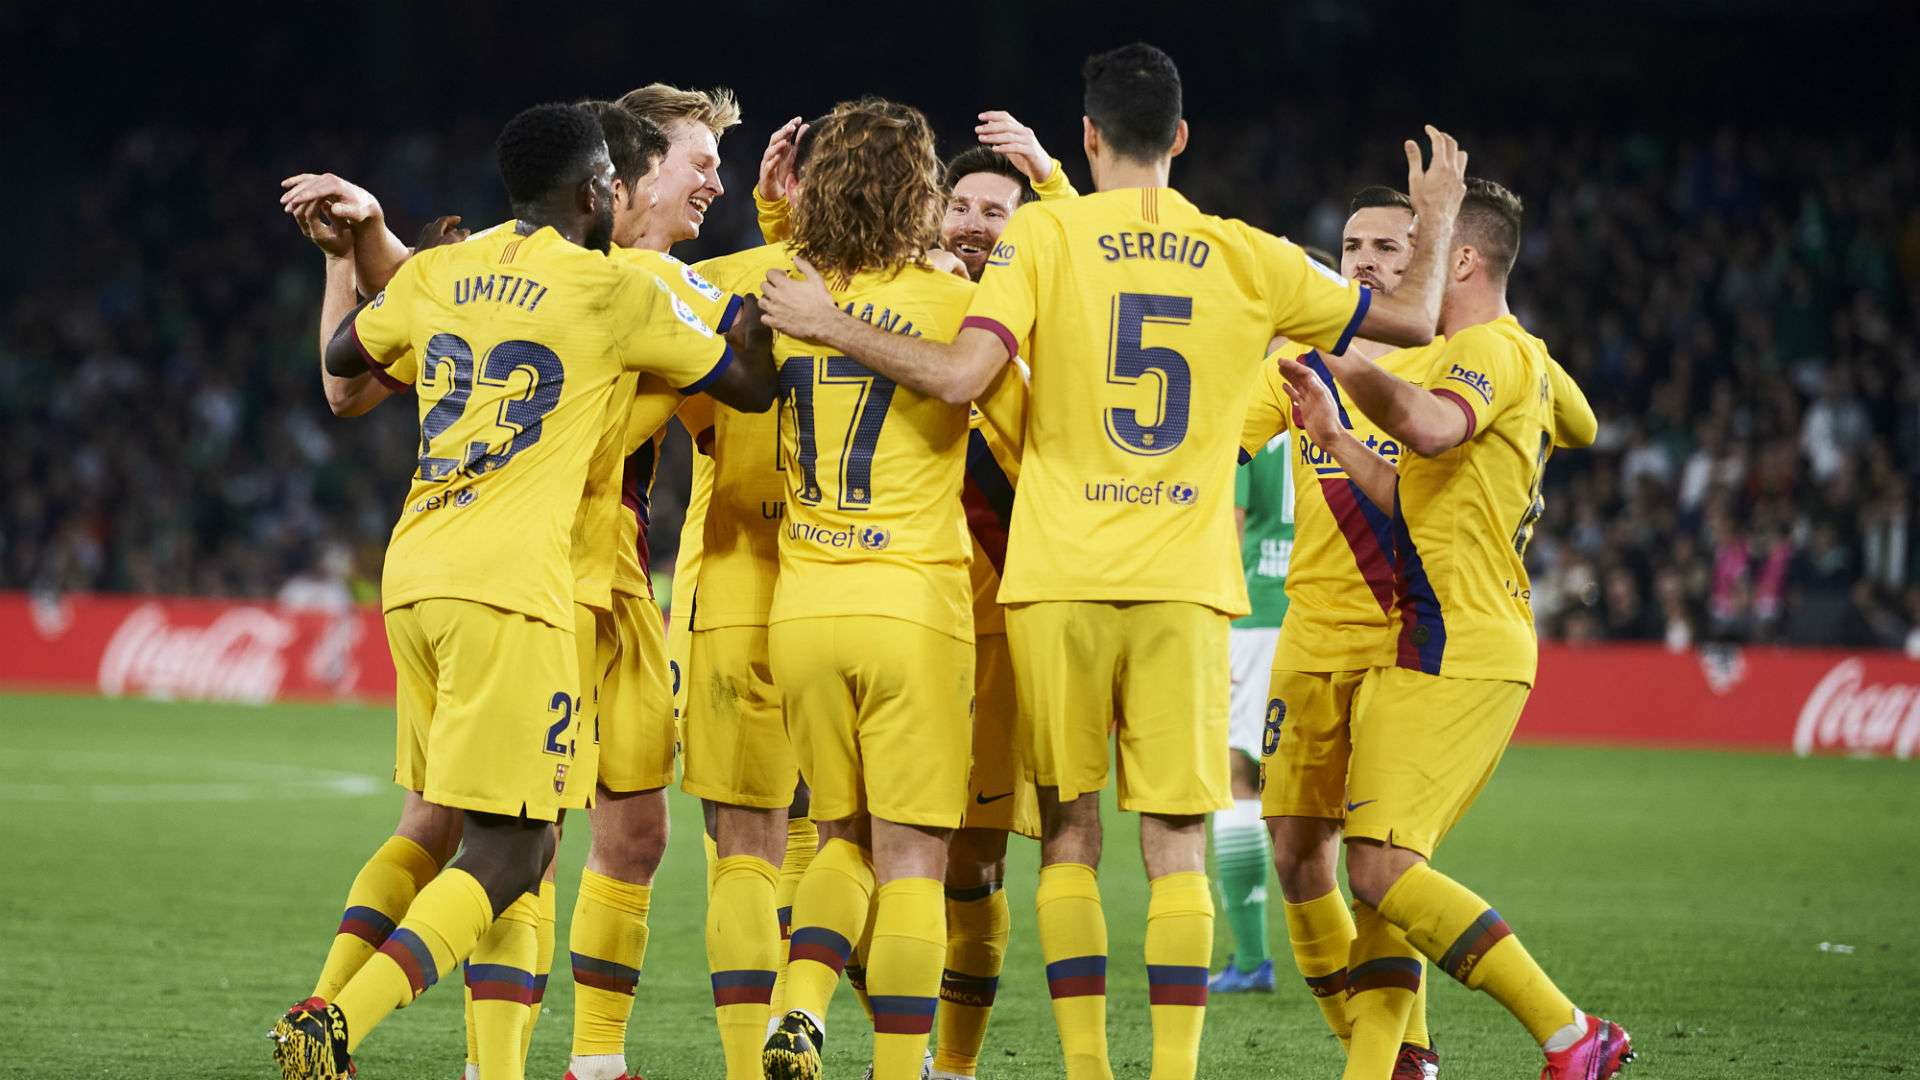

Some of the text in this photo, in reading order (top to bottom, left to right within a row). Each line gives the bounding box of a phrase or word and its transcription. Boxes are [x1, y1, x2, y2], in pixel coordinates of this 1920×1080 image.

[992, 241, 1016, 259] ko
[1098, 231, 1210, 270] SERGIO
[454, 273, 549, 314] UMTITI
[1104, 292, 1193, 457] 5
[413, 333, 565, 482] 23
[777, 356, 897, 510] 17
[1085, 478, 1164, 505] unicef
[787, 521, 856, 549] unicef
